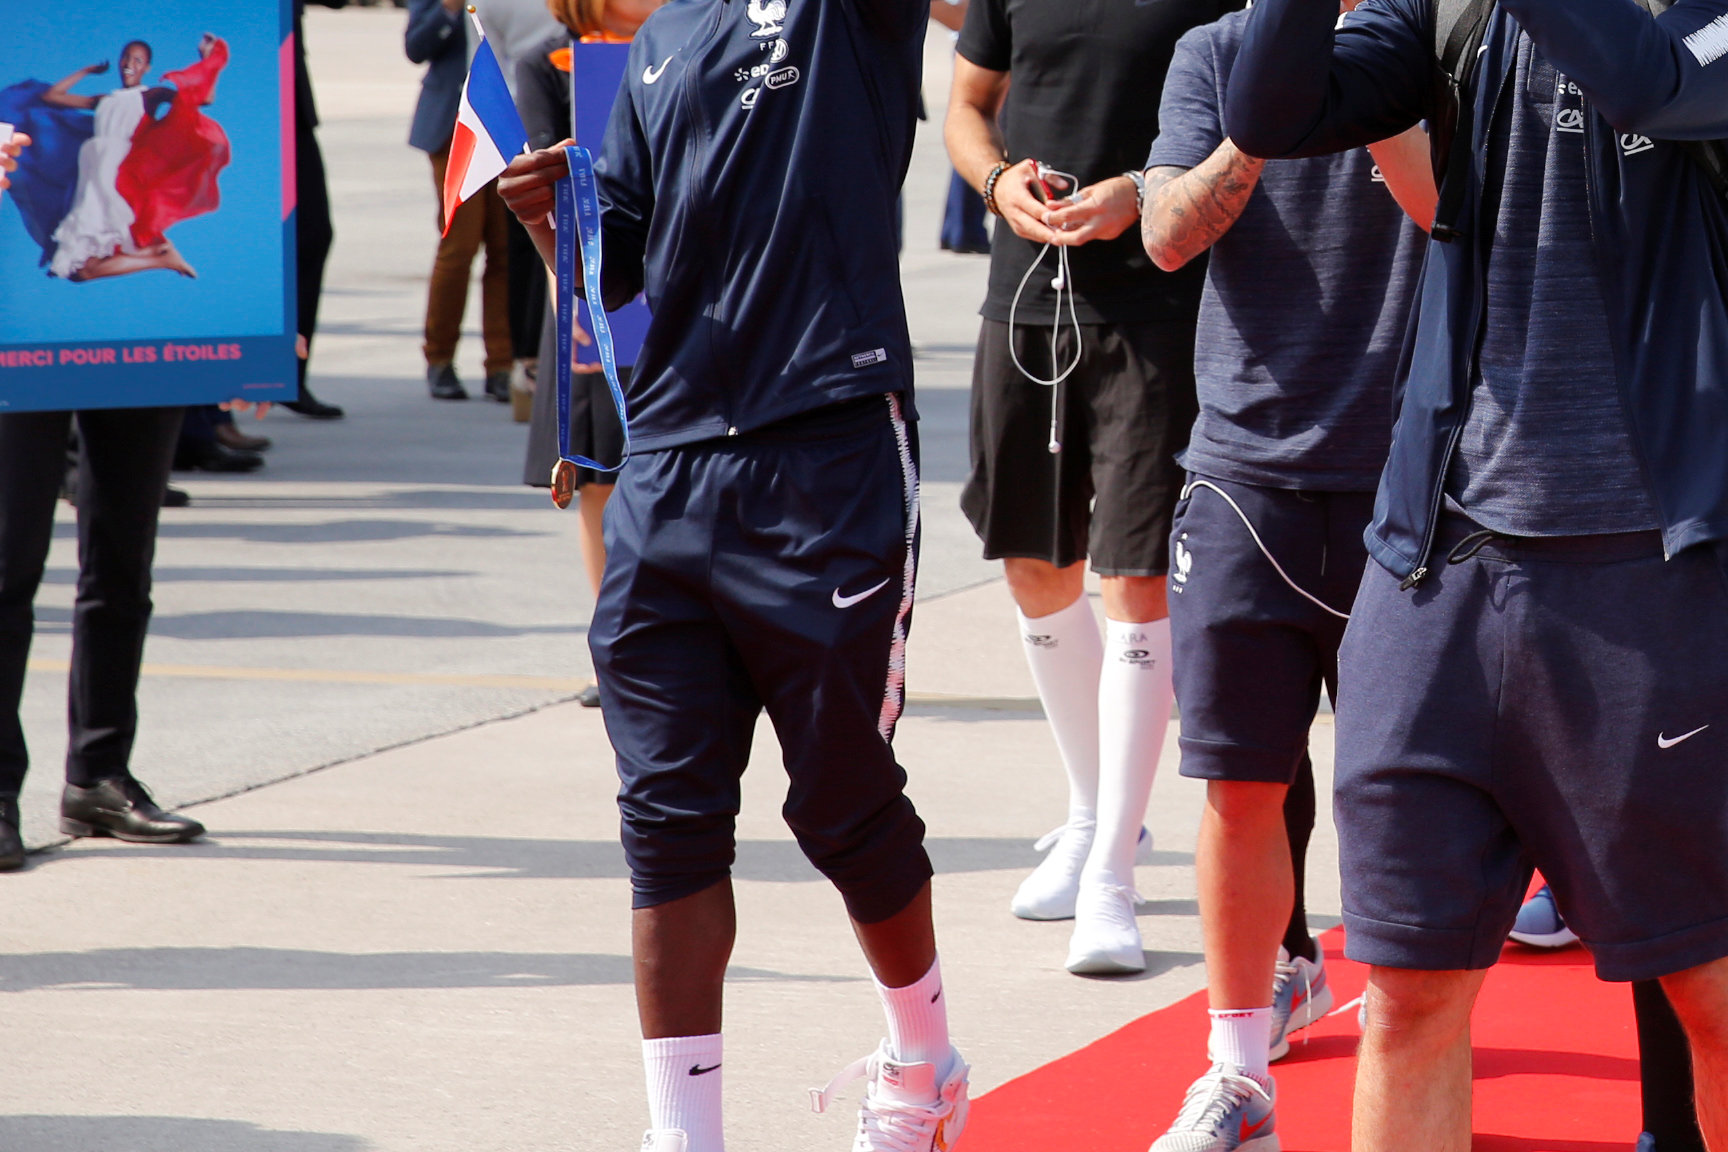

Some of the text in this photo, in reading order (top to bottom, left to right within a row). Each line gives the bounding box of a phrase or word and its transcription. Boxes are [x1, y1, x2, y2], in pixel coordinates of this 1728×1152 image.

[750, 64, 770, 78] eD
[59, 348, 116, 366] POUR
[123, 346, 157, 363] LES
[163, 342, 242, 362] ÉTOILES
